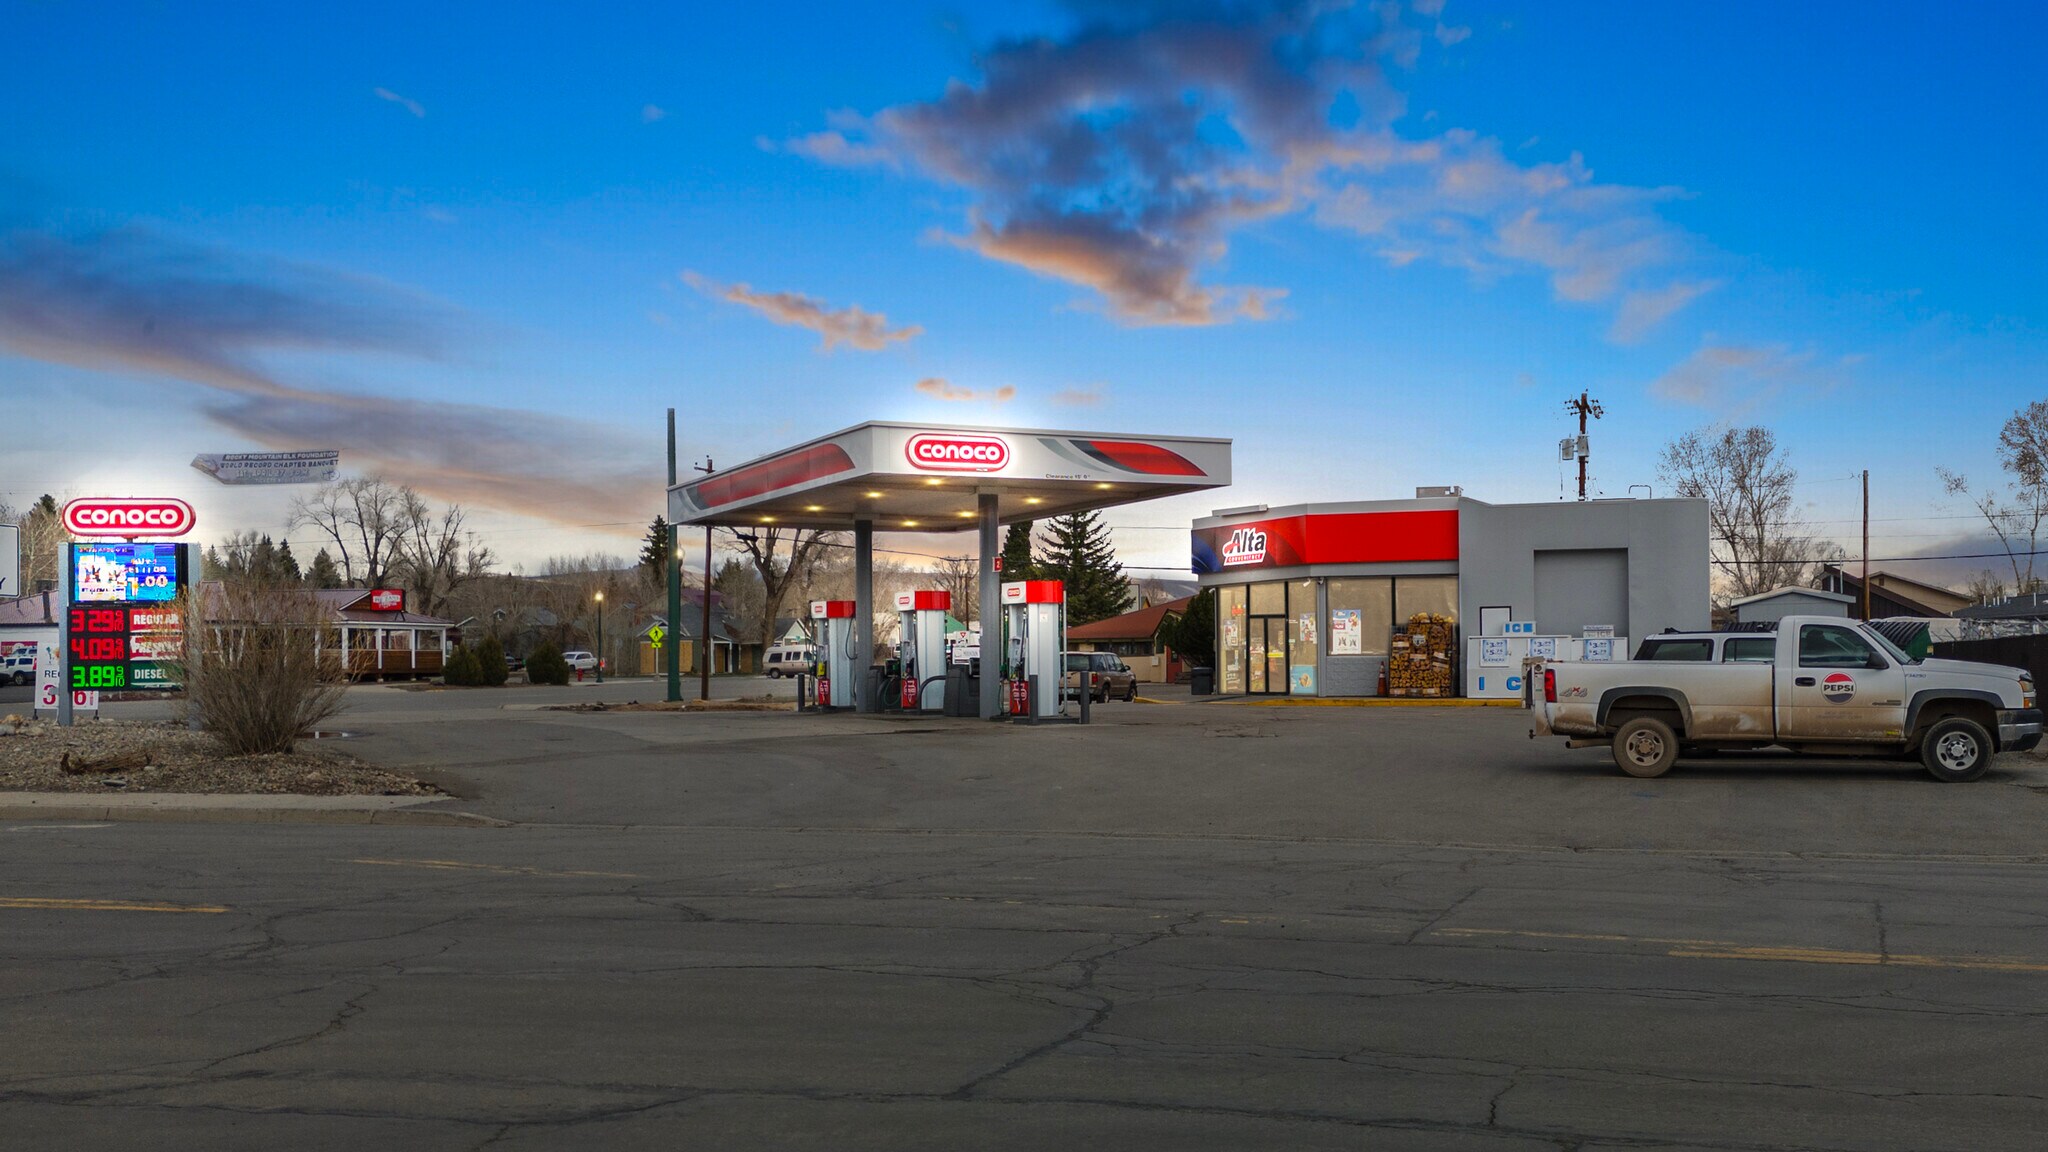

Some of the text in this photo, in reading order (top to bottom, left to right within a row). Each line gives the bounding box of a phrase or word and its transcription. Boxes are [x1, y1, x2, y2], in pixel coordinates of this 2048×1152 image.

[283, 452, 297, 460] ELK
[297, 451, 338, 459] FOUNDATION
[244, 461, 272, 469] RECORD
[1224, 530, 1266, 554] Alta
[1823, 684, 1854, 692] PEPSI
